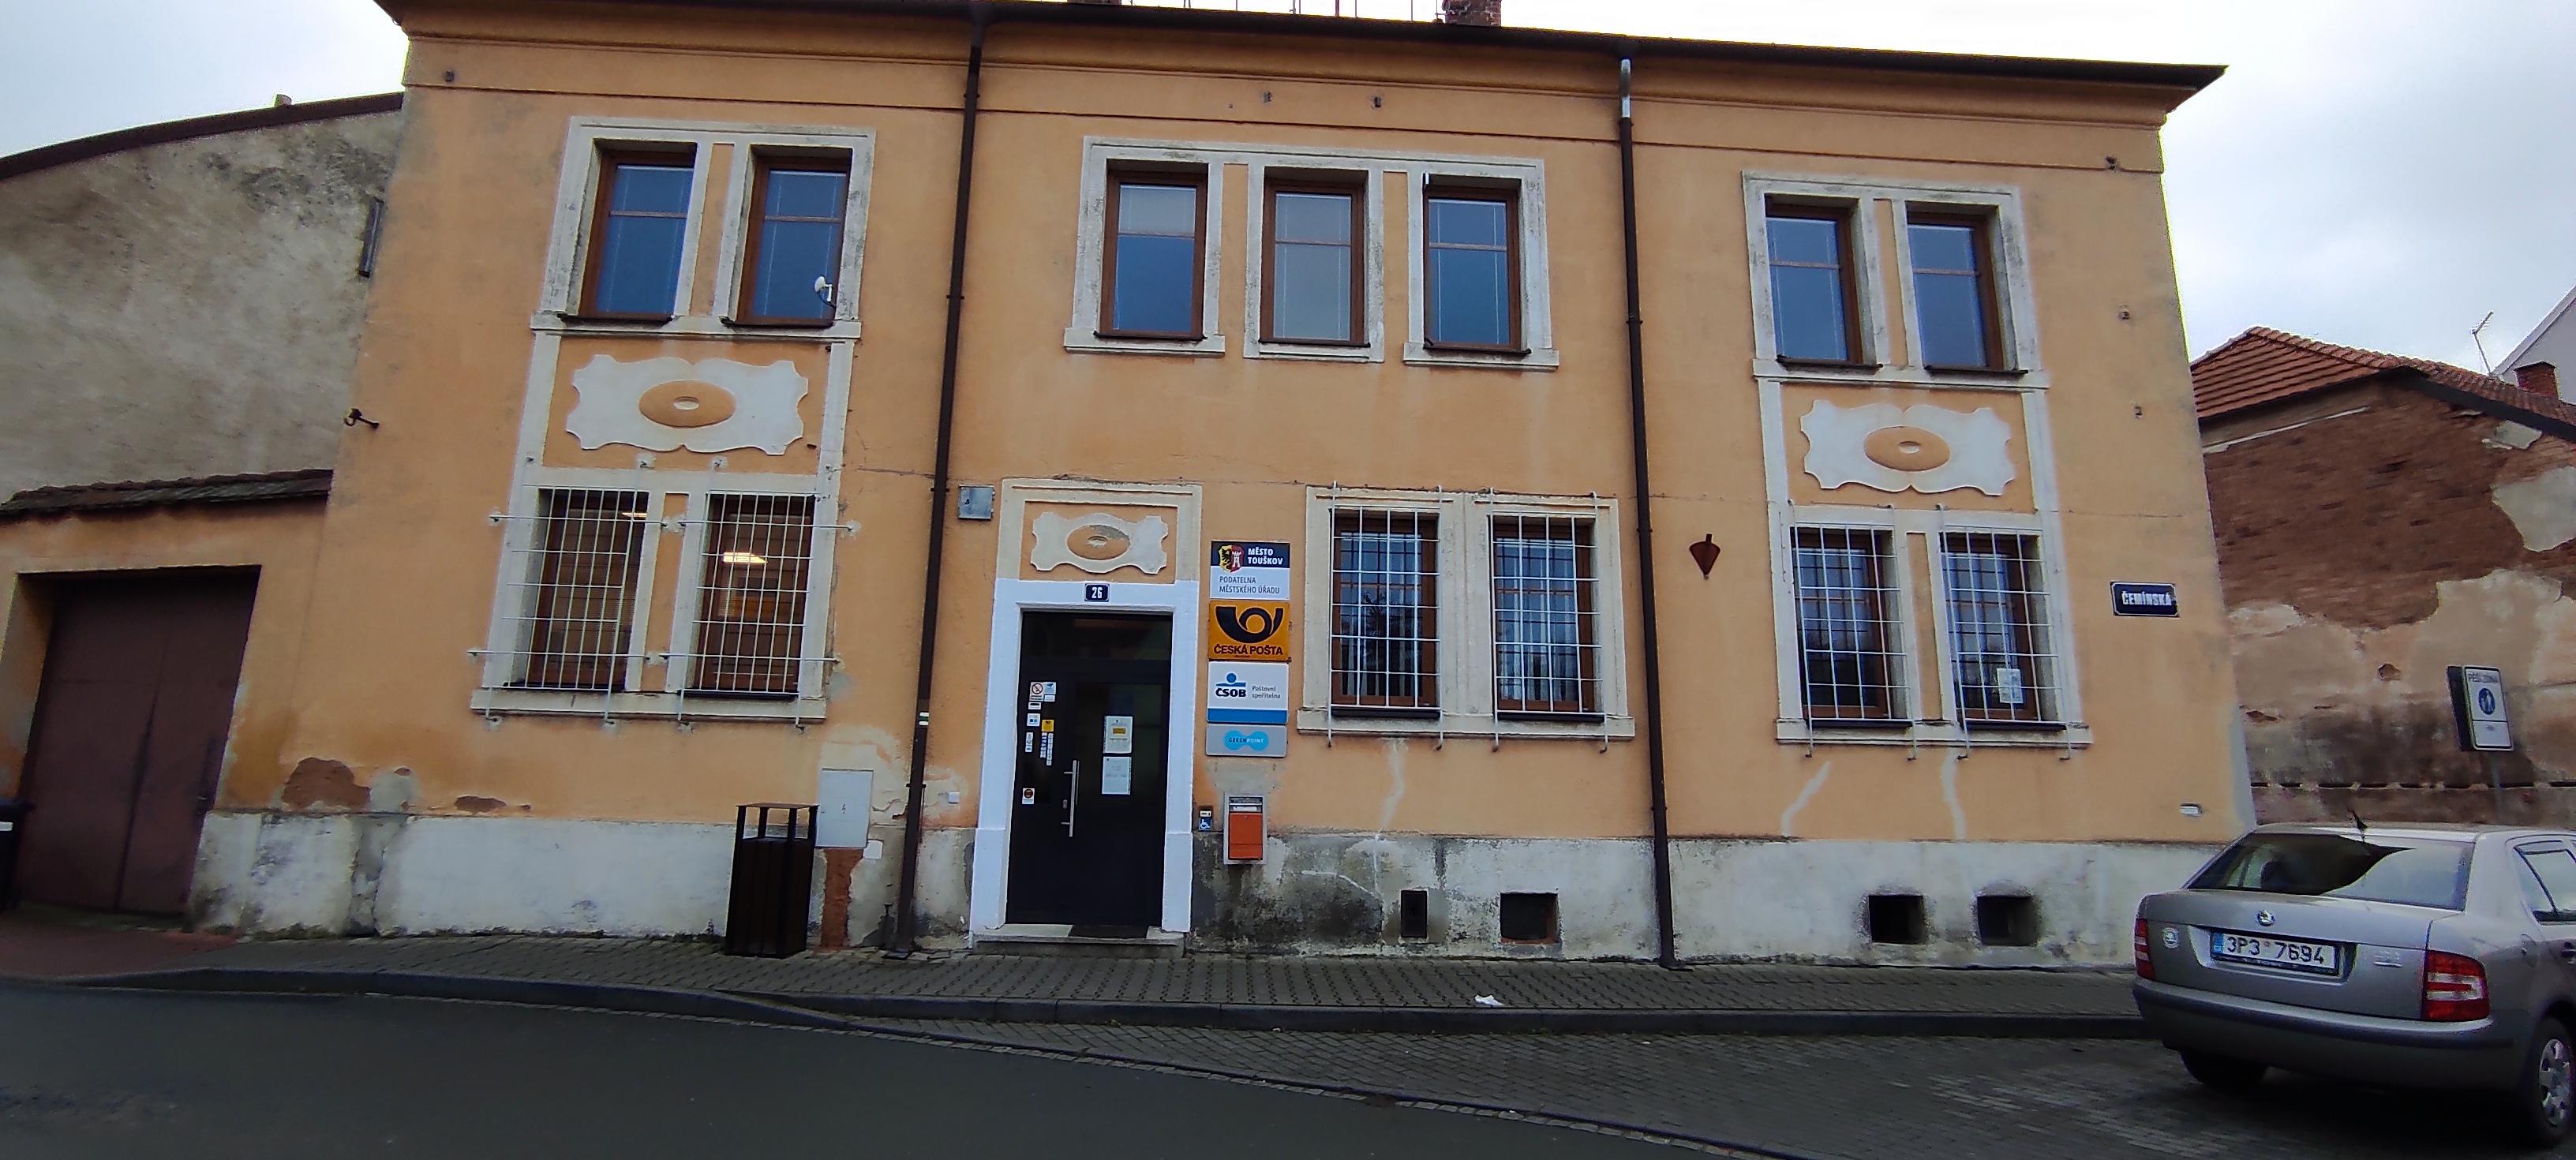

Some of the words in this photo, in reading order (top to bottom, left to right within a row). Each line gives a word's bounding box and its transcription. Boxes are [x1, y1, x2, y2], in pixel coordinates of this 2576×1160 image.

[1248, 546, 1274, 556] MĚSTO
[1247, 556, 1283, 565] TOUŠKOV
[1091, 586, 1103, 599] 26
[1219, 585, 1256, 593] MĚSTSKÉHO
[2121, 590, 2172, 606] ČEMÍNSKÁ
[1213, 643, 1248, 654] ČESKÁ
[1249, 645, 1283, 655] POŠTA
[1215, 687, 1247, 698] ČSOB
[2226, 937, 2260, 956] 3P3
[2275, 941, 2324, 964] 7694
